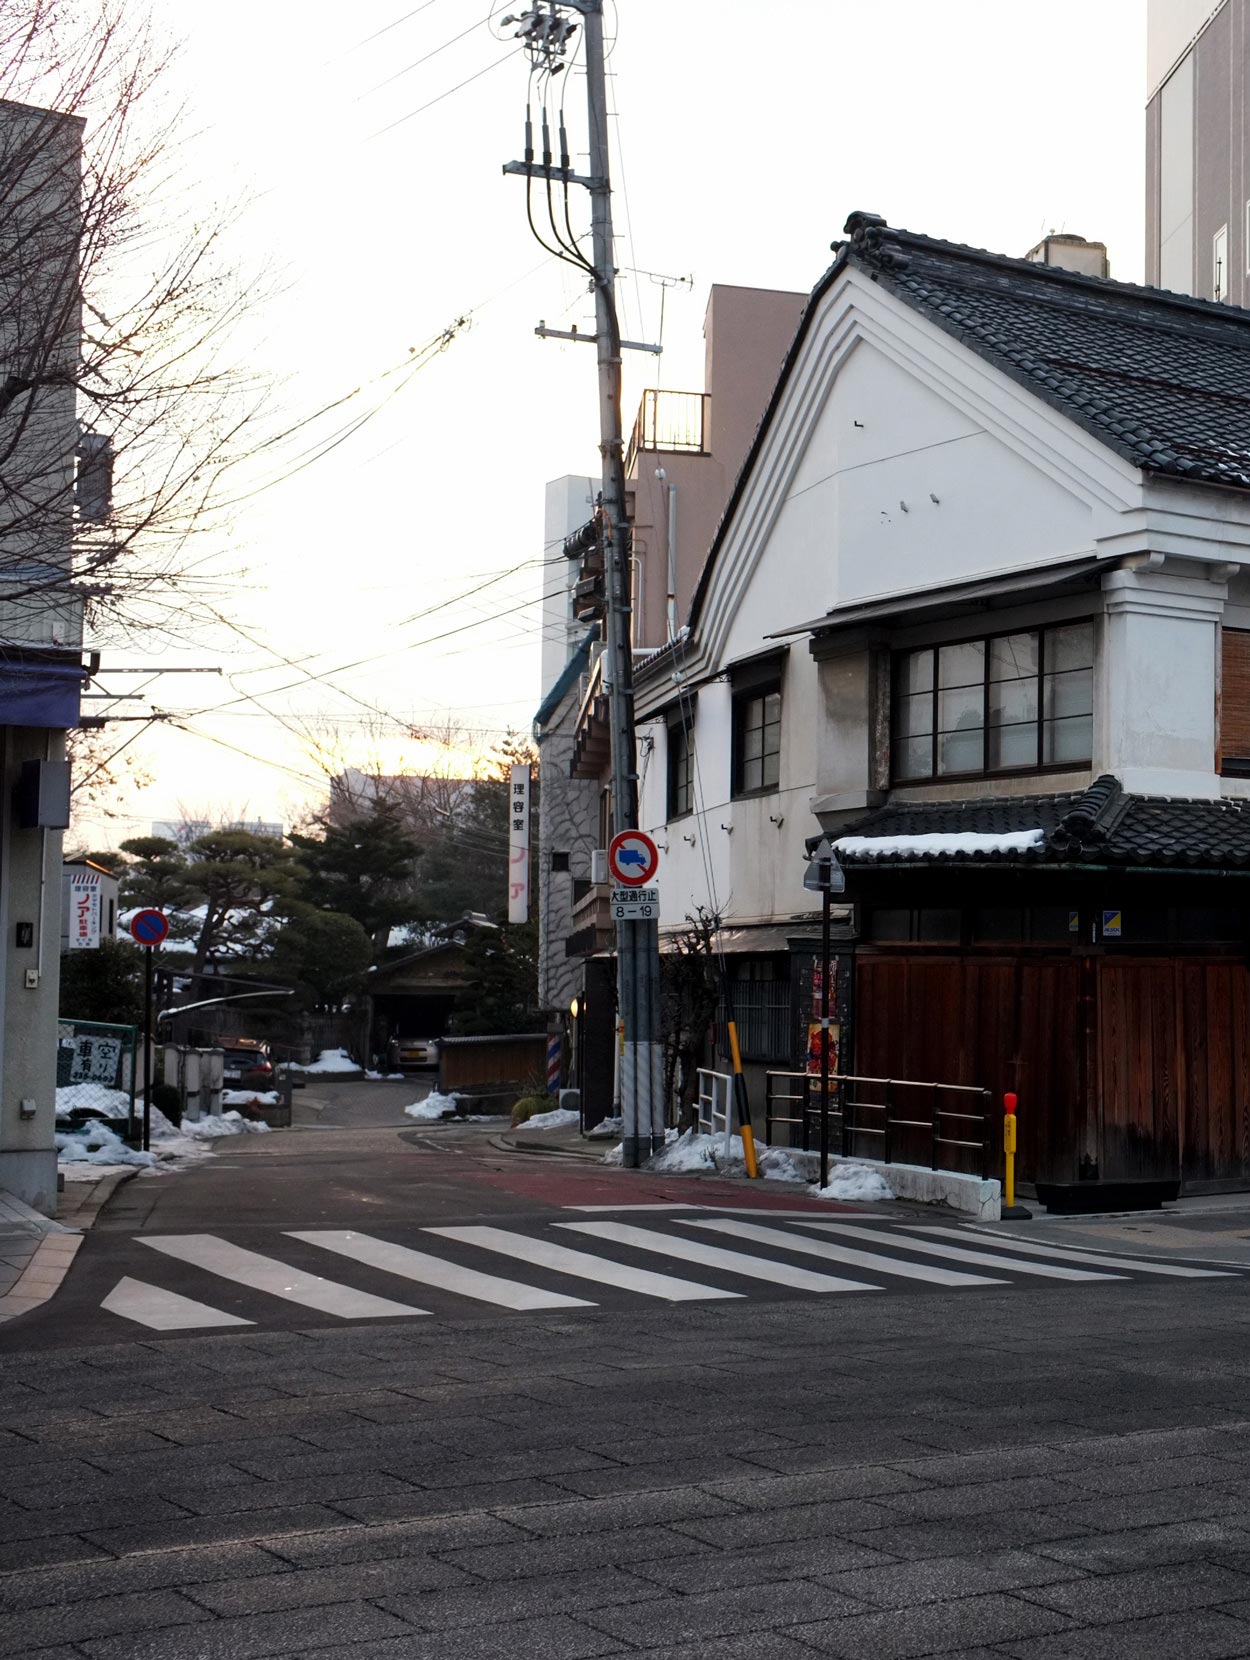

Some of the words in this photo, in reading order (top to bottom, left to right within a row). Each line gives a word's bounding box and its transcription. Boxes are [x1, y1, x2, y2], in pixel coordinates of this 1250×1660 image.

[513, 783, 525, 831] 理容室
[511, 847, 526, 900] ノア
[611, 890, 657, 902] 大型通行止
